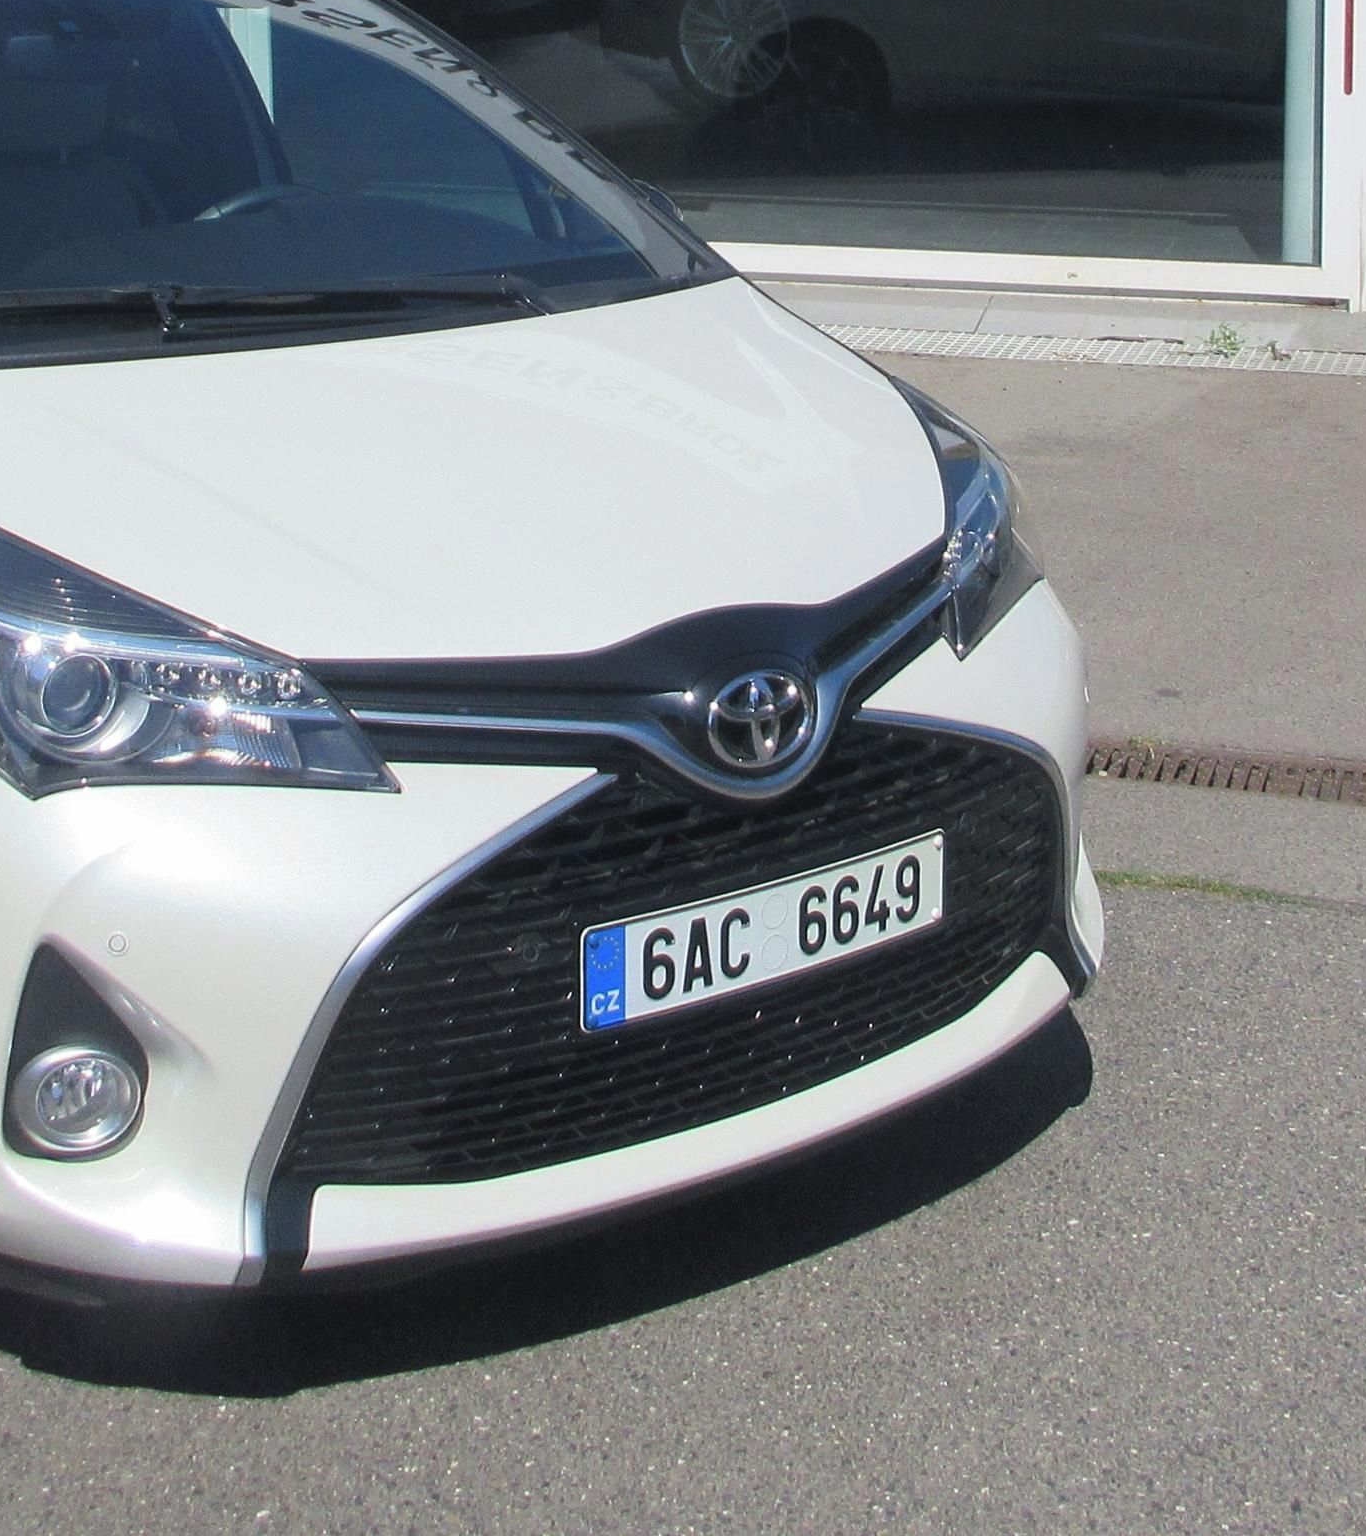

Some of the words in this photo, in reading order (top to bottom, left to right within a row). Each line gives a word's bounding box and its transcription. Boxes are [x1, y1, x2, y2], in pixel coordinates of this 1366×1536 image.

[641, 907, 751, 1001] 6AC
[797, 854, 922, 956] 6649
[590, 988, 620, 1016] CZ
